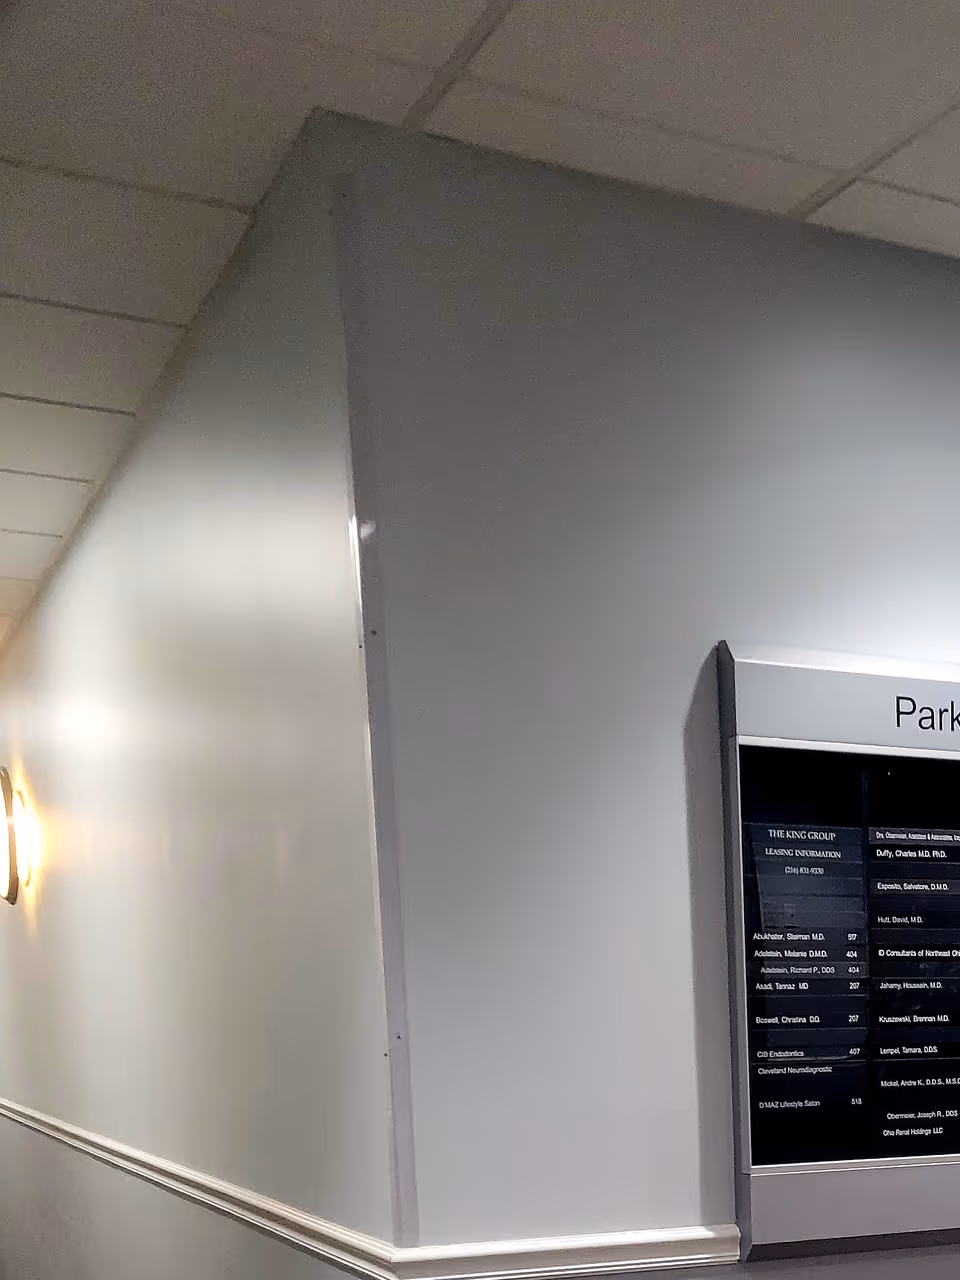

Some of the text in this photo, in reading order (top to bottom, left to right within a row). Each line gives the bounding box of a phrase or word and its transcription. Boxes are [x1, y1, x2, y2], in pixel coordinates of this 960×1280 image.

[768, 829, 836, 840] THE KING GROUP
[765, 848, 841, 859] LEASING INFORMATION
[877, 850, 893, 858] Duffy,
